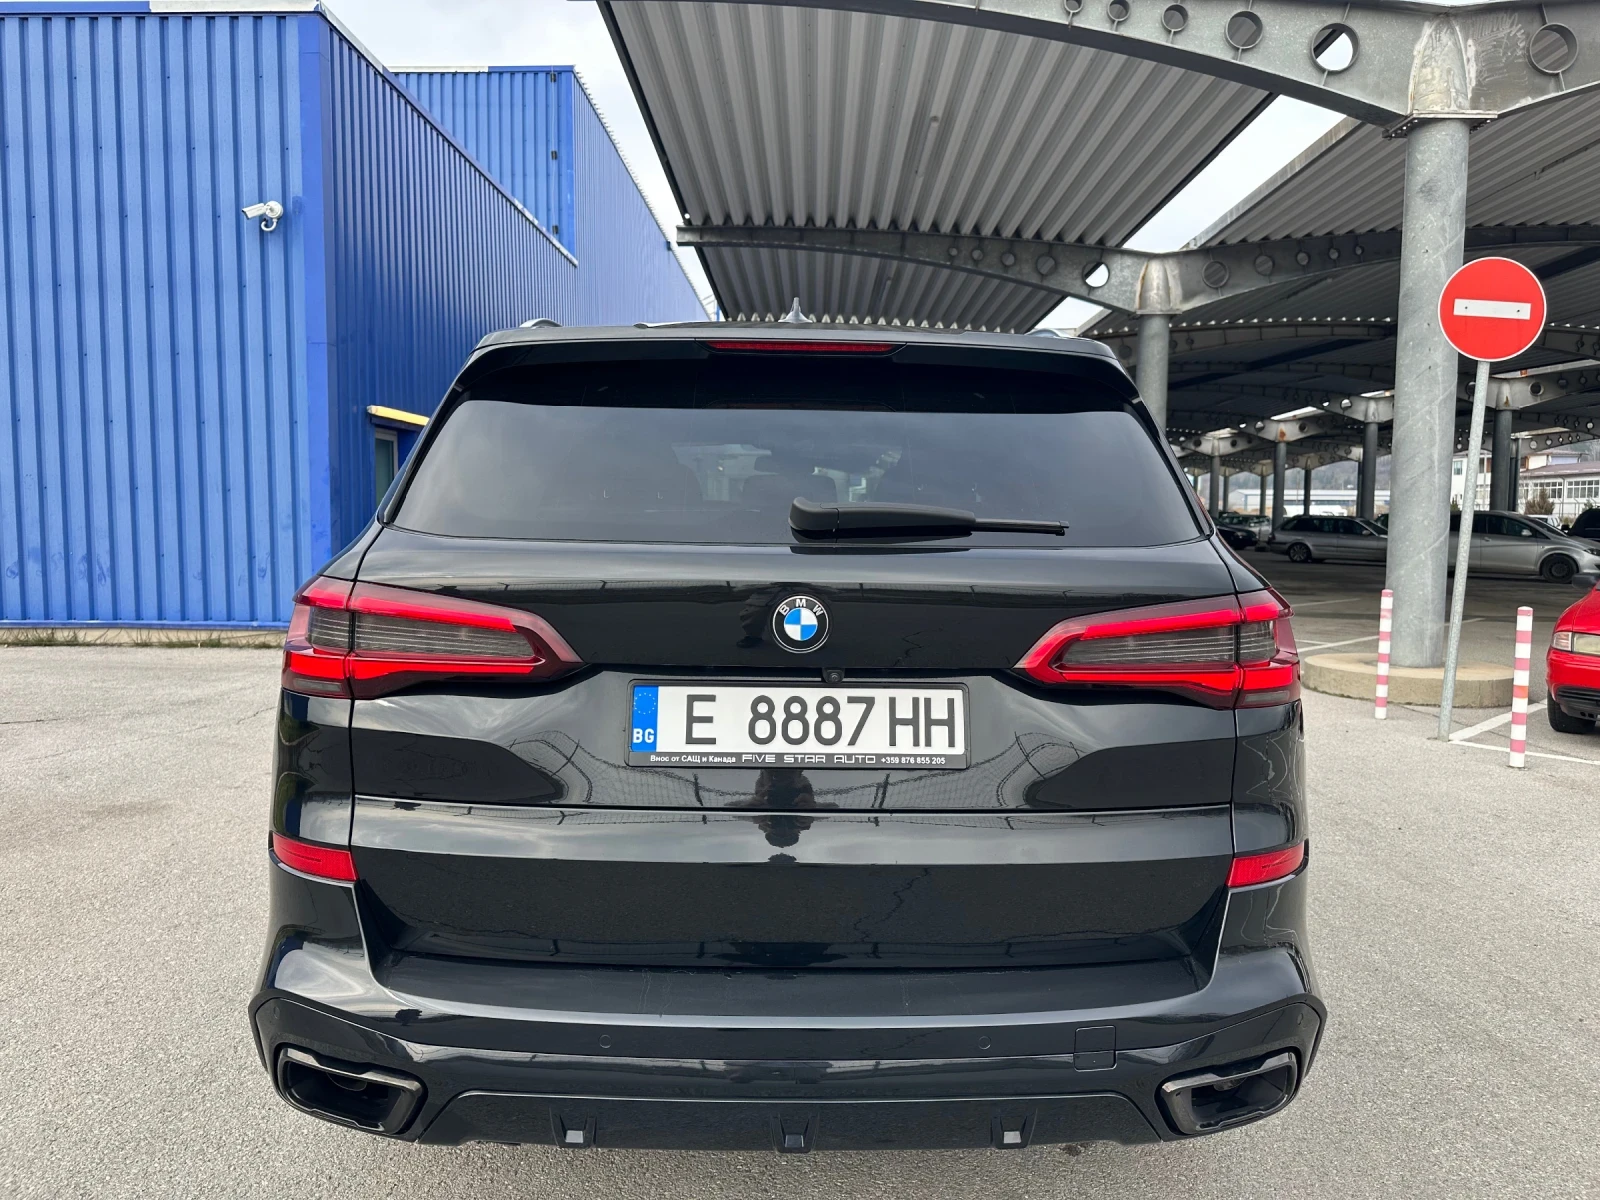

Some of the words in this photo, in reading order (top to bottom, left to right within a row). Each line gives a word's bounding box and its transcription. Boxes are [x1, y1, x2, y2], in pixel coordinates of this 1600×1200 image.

[779, 598, 823, 616] BMW
[685, 694, 717, 745] E
[748, 694, 876, 746] 8887
[888, 696, 956, 748] HH
[632, 728, 655, 743] BG
[681, 755, 701, 763] САЩ
[708, 755, 736, 763] Канада
[741, 754, 776, 763] FIVE
[783, 754, 826, 763] STAR
[833, 755, 876, 764] AUTO
[931, 757, 946, 765] 205
